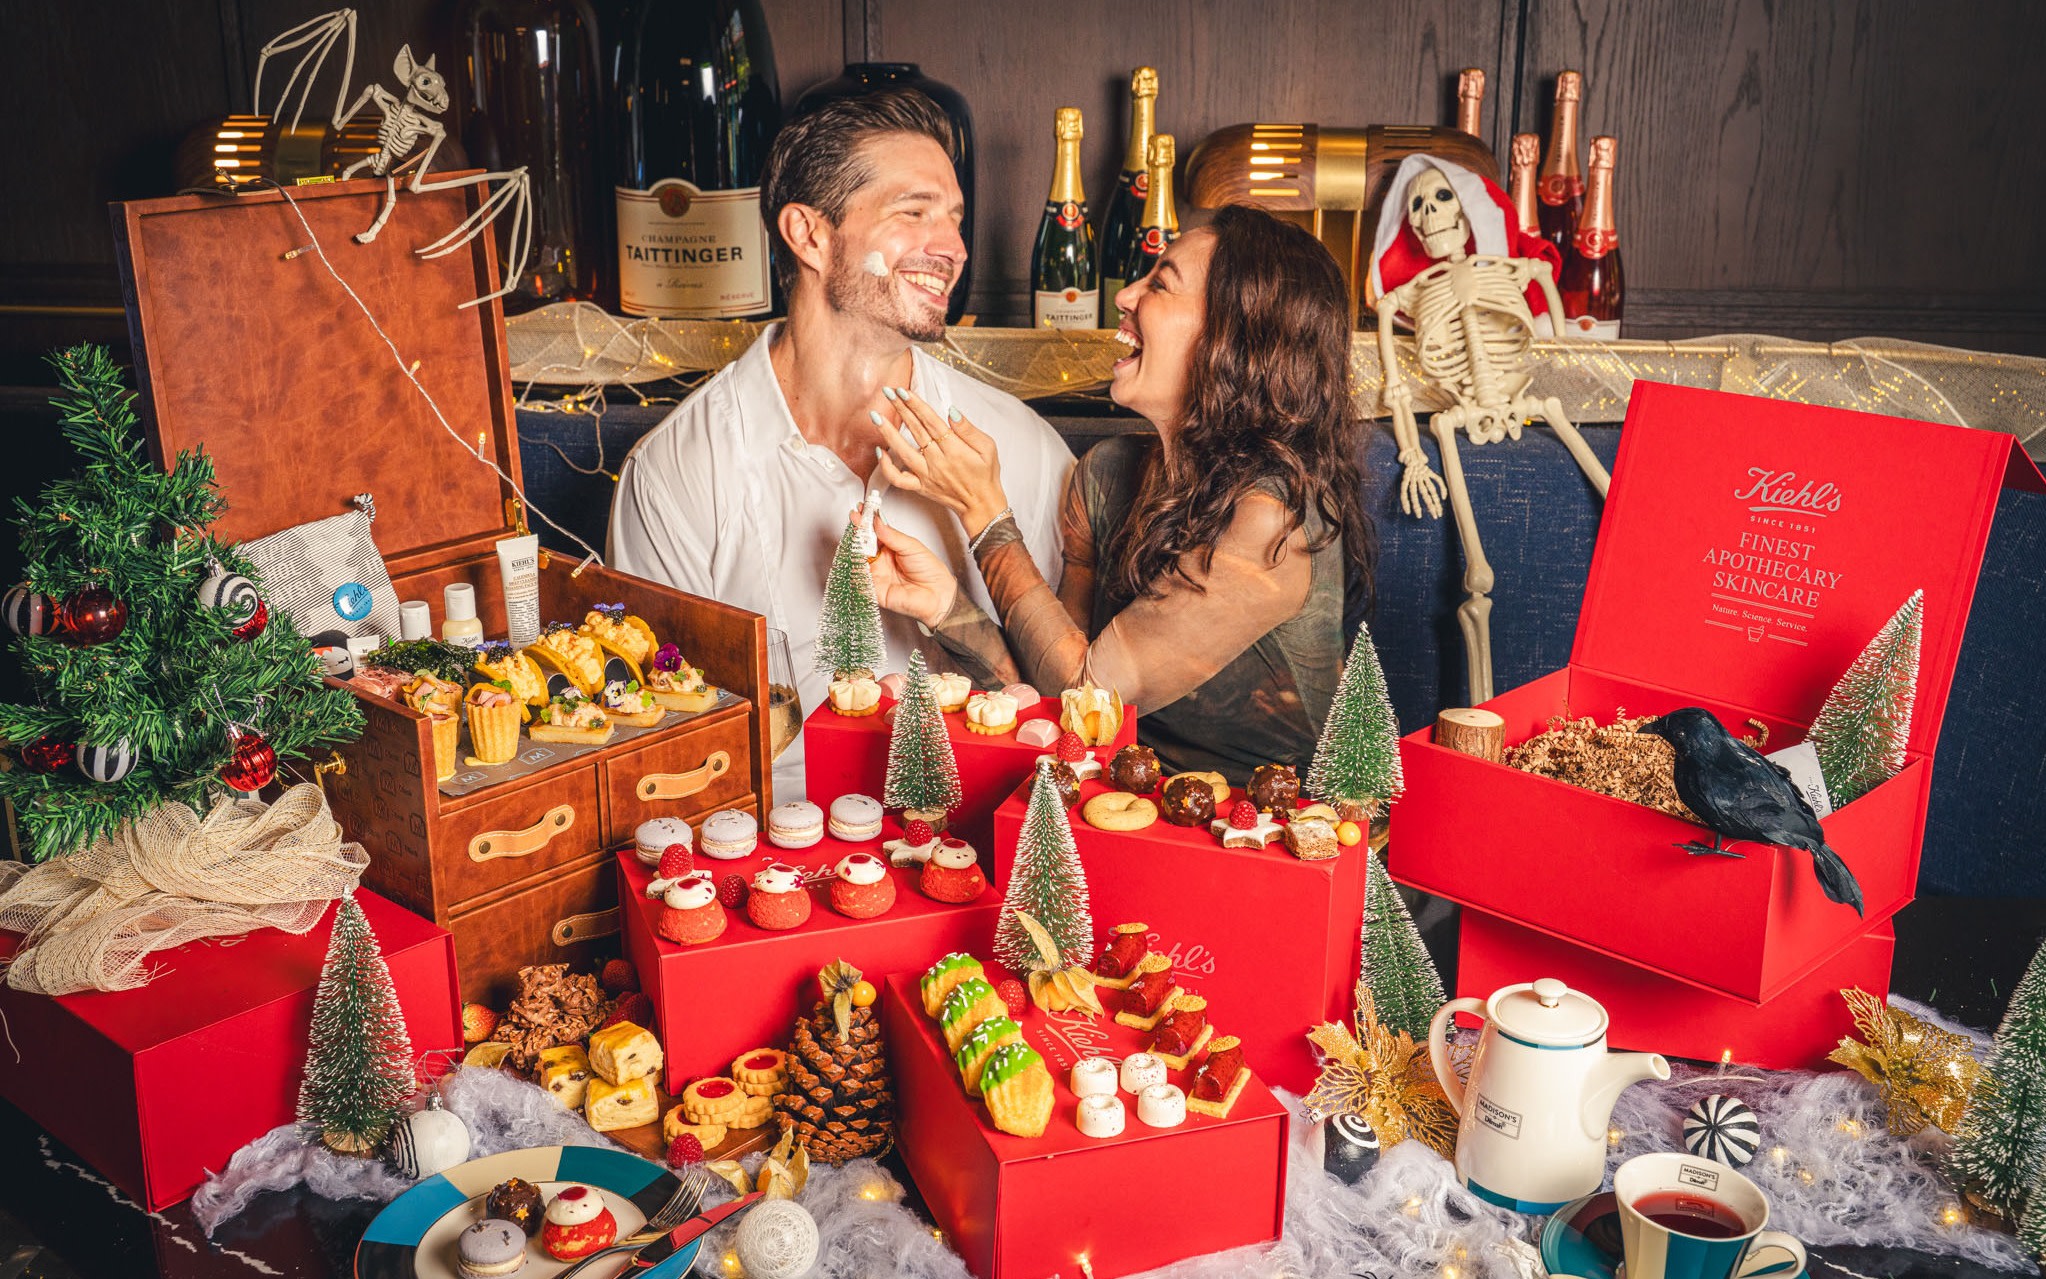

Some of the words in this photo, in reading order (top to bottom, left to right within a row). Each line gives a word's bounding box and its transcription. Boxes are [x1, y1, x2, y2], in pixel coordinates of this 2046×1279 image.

[641, 234, 717, 244] CHAMPAGNE
[625, 245, 743, 263] TAITTINGER
[1734, 466, 1842, 512] Kiehl's
[1750, 515, 1784, 528] SINCE
[1789, 523, 1816, 534] 1851
[1740, 531, 1816, 562] FINEST
[1702, 548, 1843, 590] APOTHECARY
[1713, 571, 1820, 609] SKINCARE
[1712, 604, 1739, 617] Nature.
[1742, 610, 1773, 624] Science.
[1776, 618, 1808, 633] Service.
[1807, 784, 1824, 813] Kiehl's
[1036, 1029, 1057, 1052] SINCE
[1054, 1054, 1071, 1071] 1851
[1048, 1011, 1123, 1068] Kiehl
[1480, 1099, 1517, 1123] MADISON'S
[1683, 1167, 1716, 1180] MADISON'S
